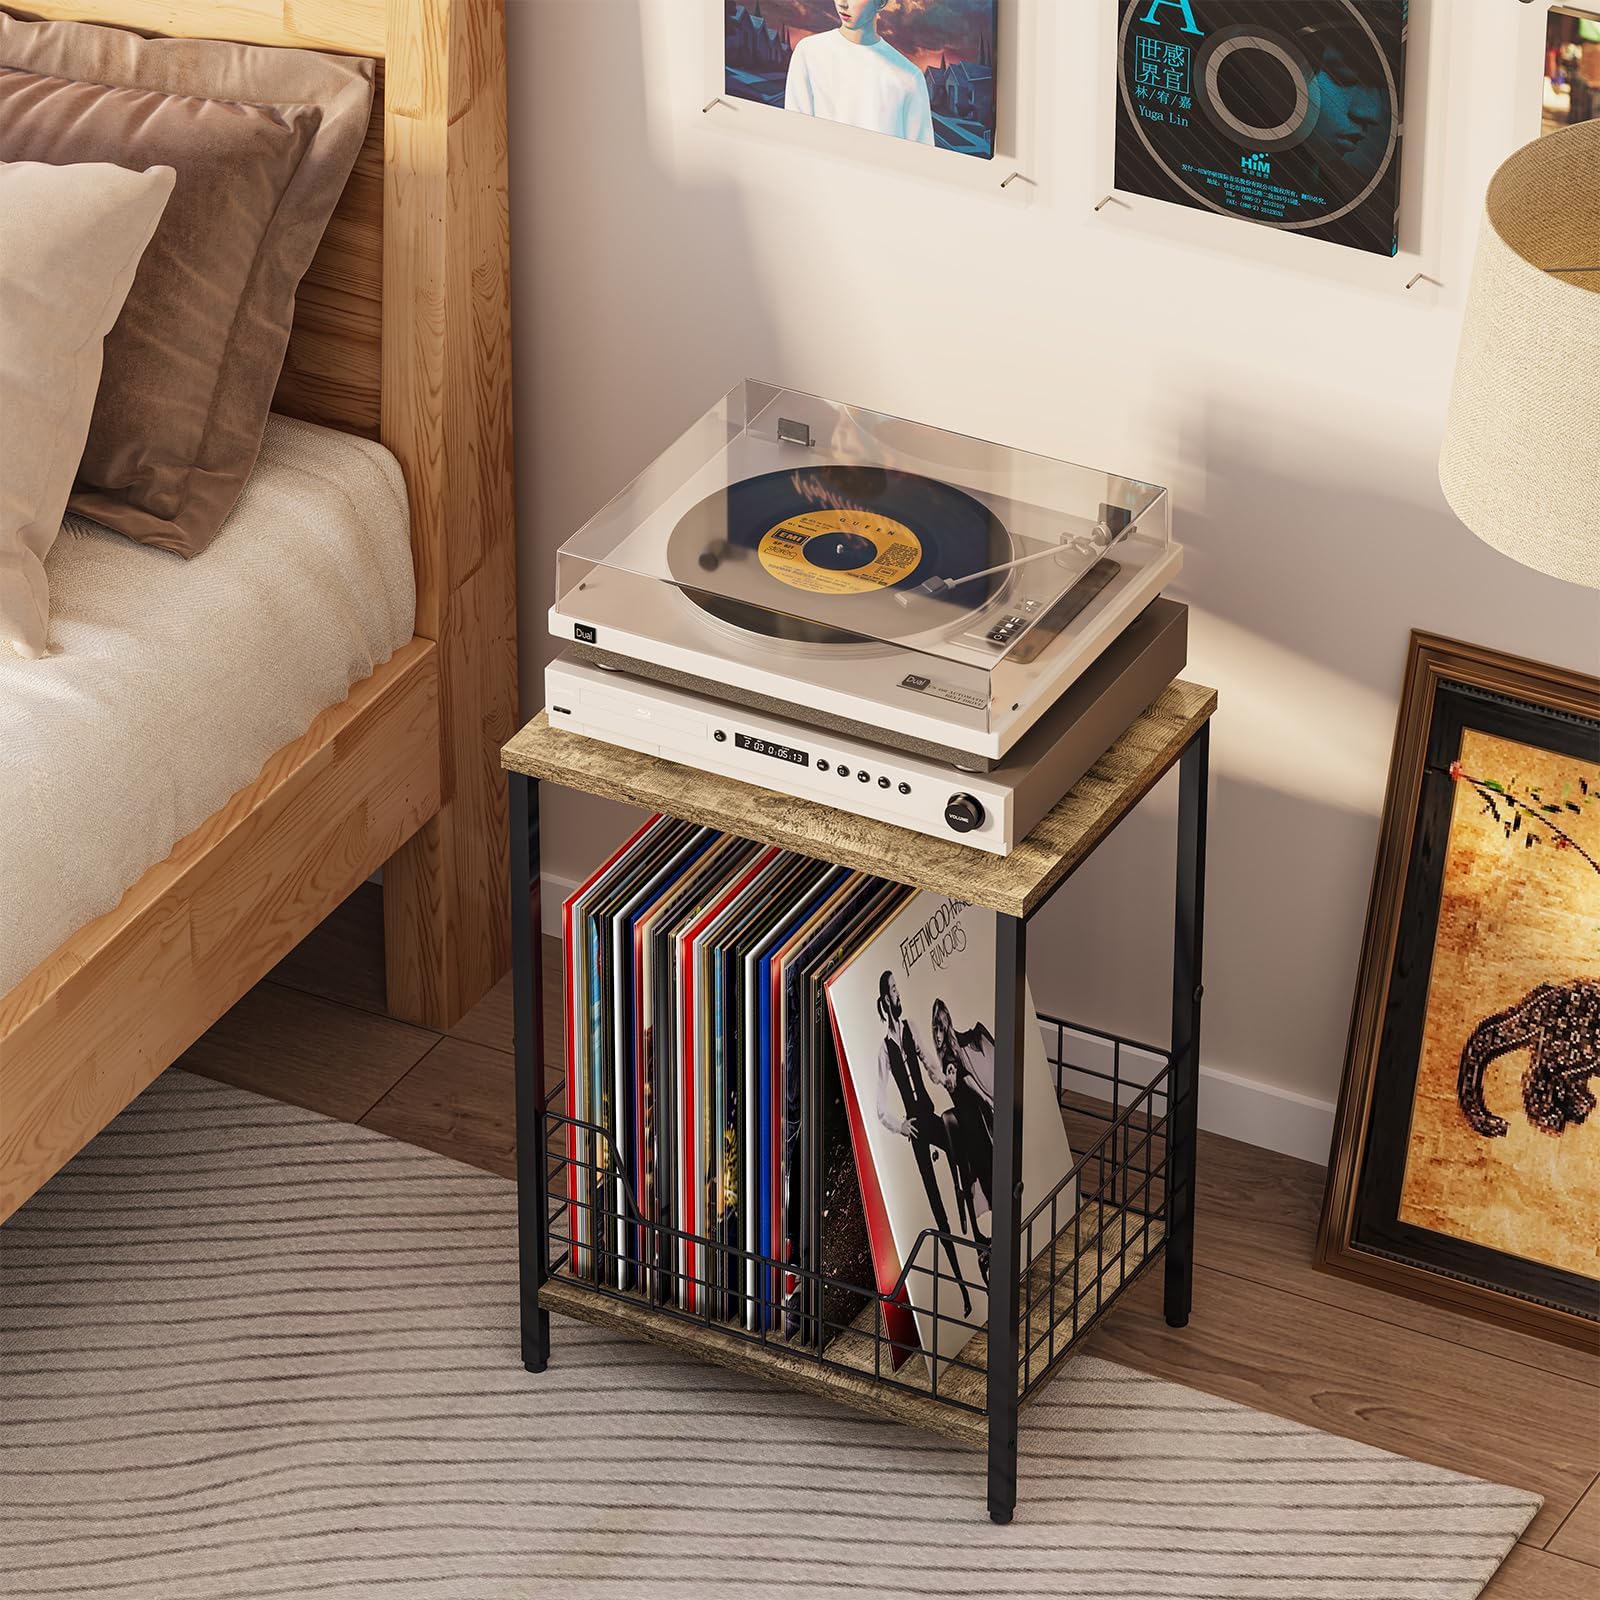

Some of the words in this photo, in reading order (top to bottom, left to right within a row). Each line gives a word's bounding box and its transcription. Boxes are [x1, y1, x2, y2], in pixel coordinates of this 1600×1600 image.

[1140, 0, 1204, 36] A
[1138, 105, 1164, 121] Yuga
[1169, 112, 1189, 127] Lin
[840, 518, 896, 536] QUEEN
[779, 531, 803, 542] EMI
[576, 628, 593, 641] Dual
[906, 675, 926, 686] Dual
[754, 742, 765, 752] 03
[948, 813, 970, 824] VOLUME
[900, 903, 951, 977] FLEETWOOD
[930, 921, 967, 972] RUMOURS
